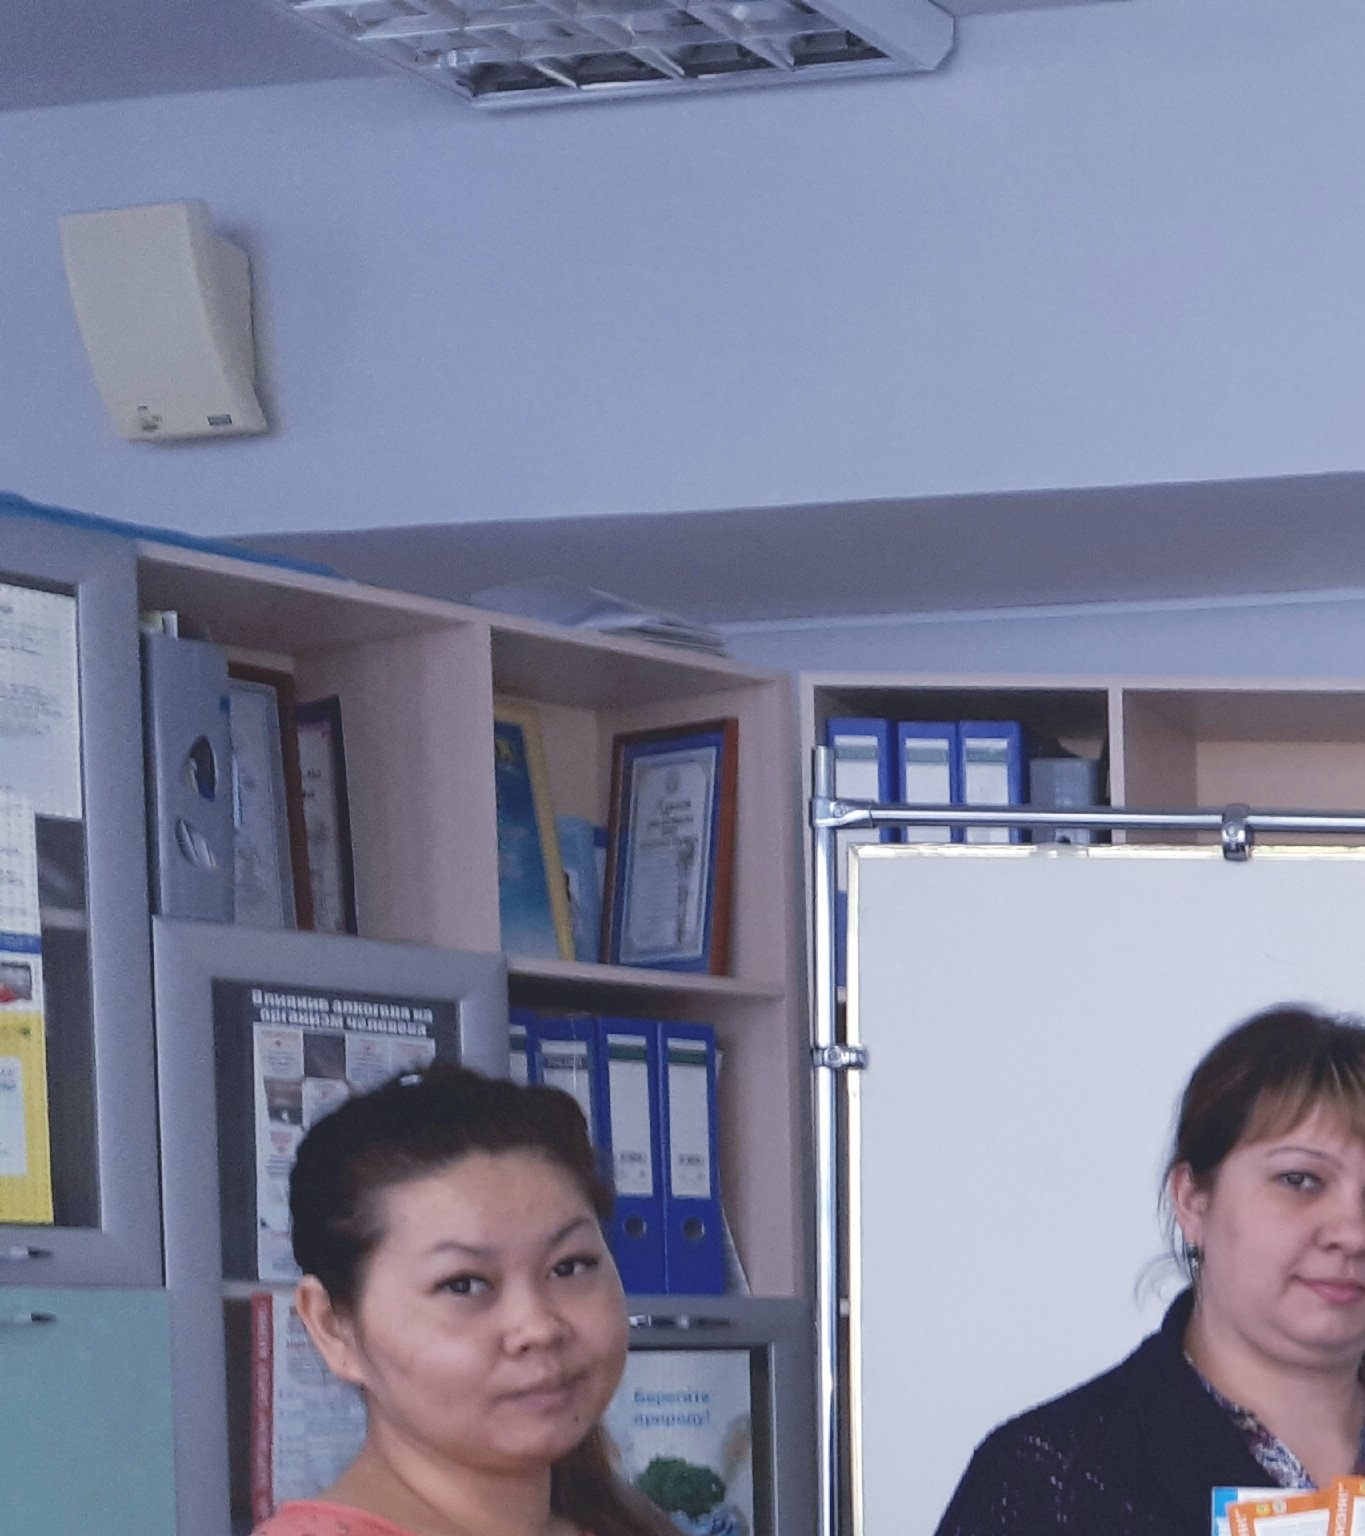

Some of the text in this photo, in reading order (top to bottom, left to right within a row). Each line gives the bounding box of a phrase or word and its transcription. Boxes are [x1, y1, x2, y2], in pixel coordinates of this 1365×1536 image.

[252, 989, 433, 1024] Влияние алкоголя на
[260, 1008, 427, 1036] организм человека
